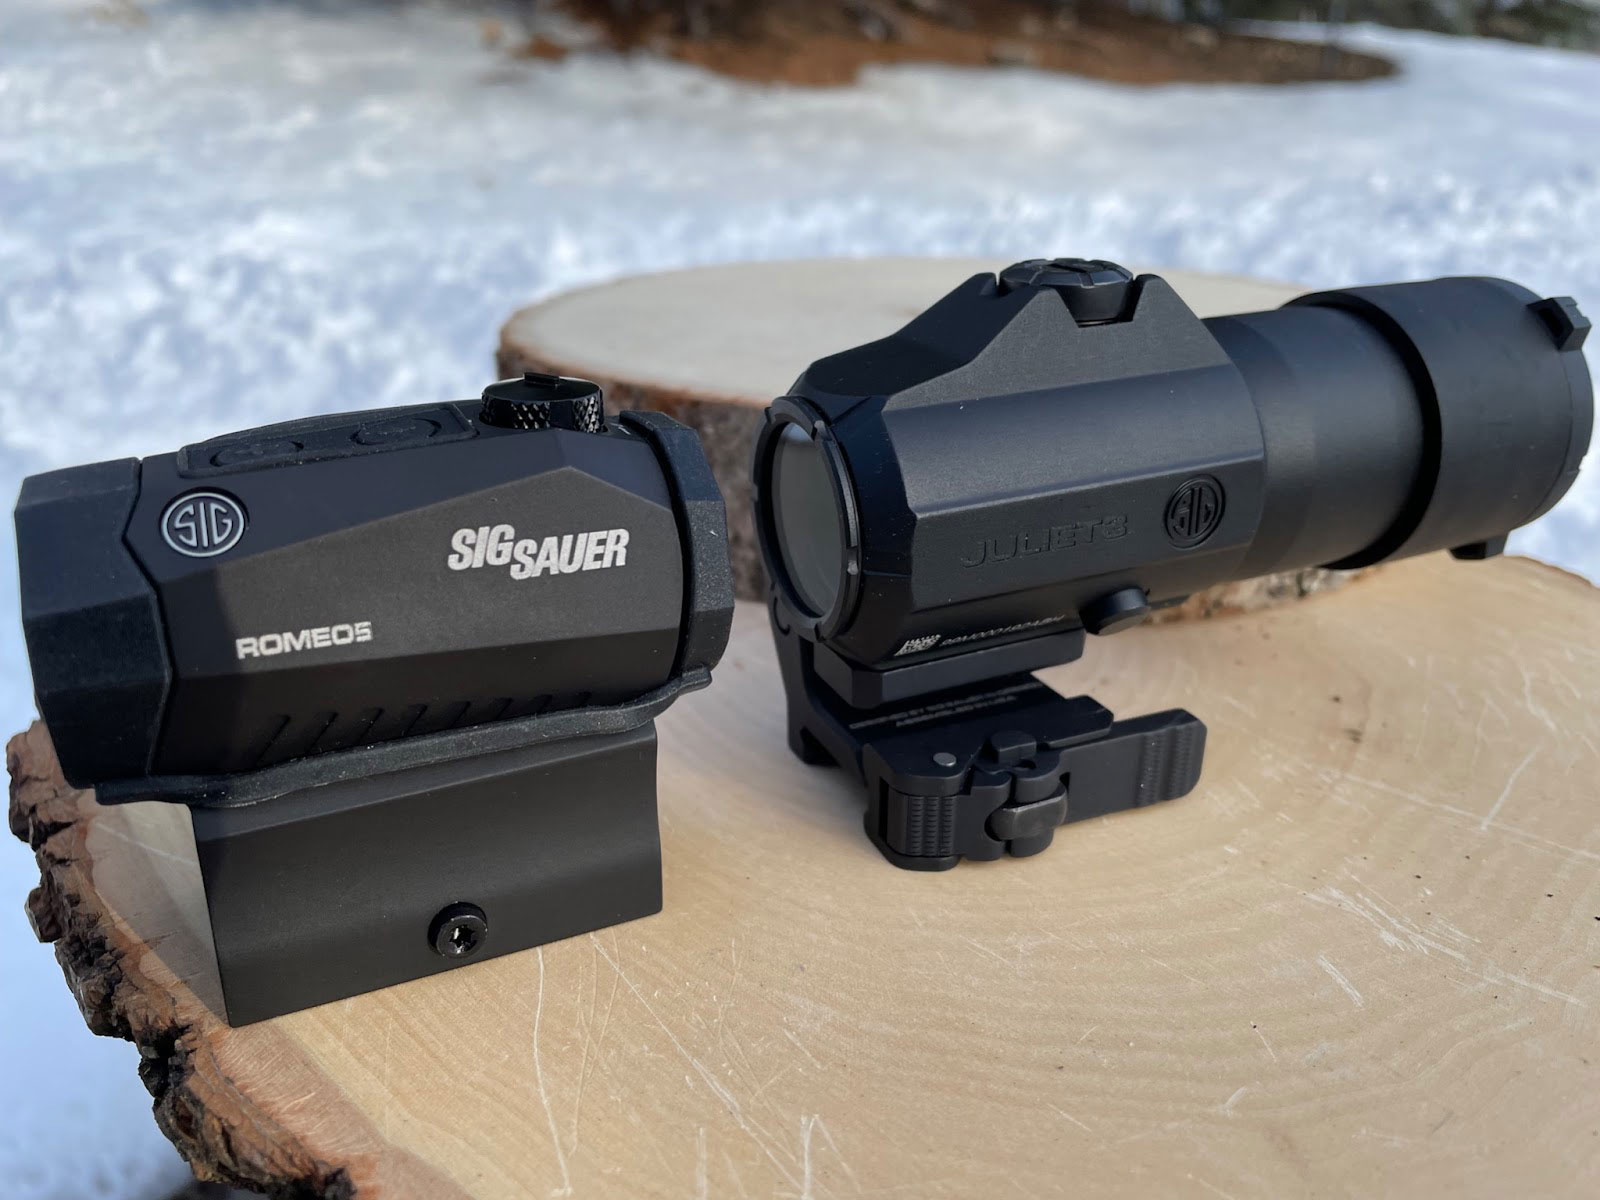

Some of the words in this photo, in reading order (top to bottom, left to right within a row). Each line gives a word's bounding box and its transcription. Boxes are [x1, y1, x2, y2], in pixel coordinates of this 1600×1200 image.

[173, 501, 234, 549] SIG
[1169, 485, 1213, 537] SIG
[447, 523, 516, 571] SIG
[510, 528, 630, 581] SAUER
[960, 514, 1129, 569] JULIET3
[235, 620, 373, 660] ROMEO5
